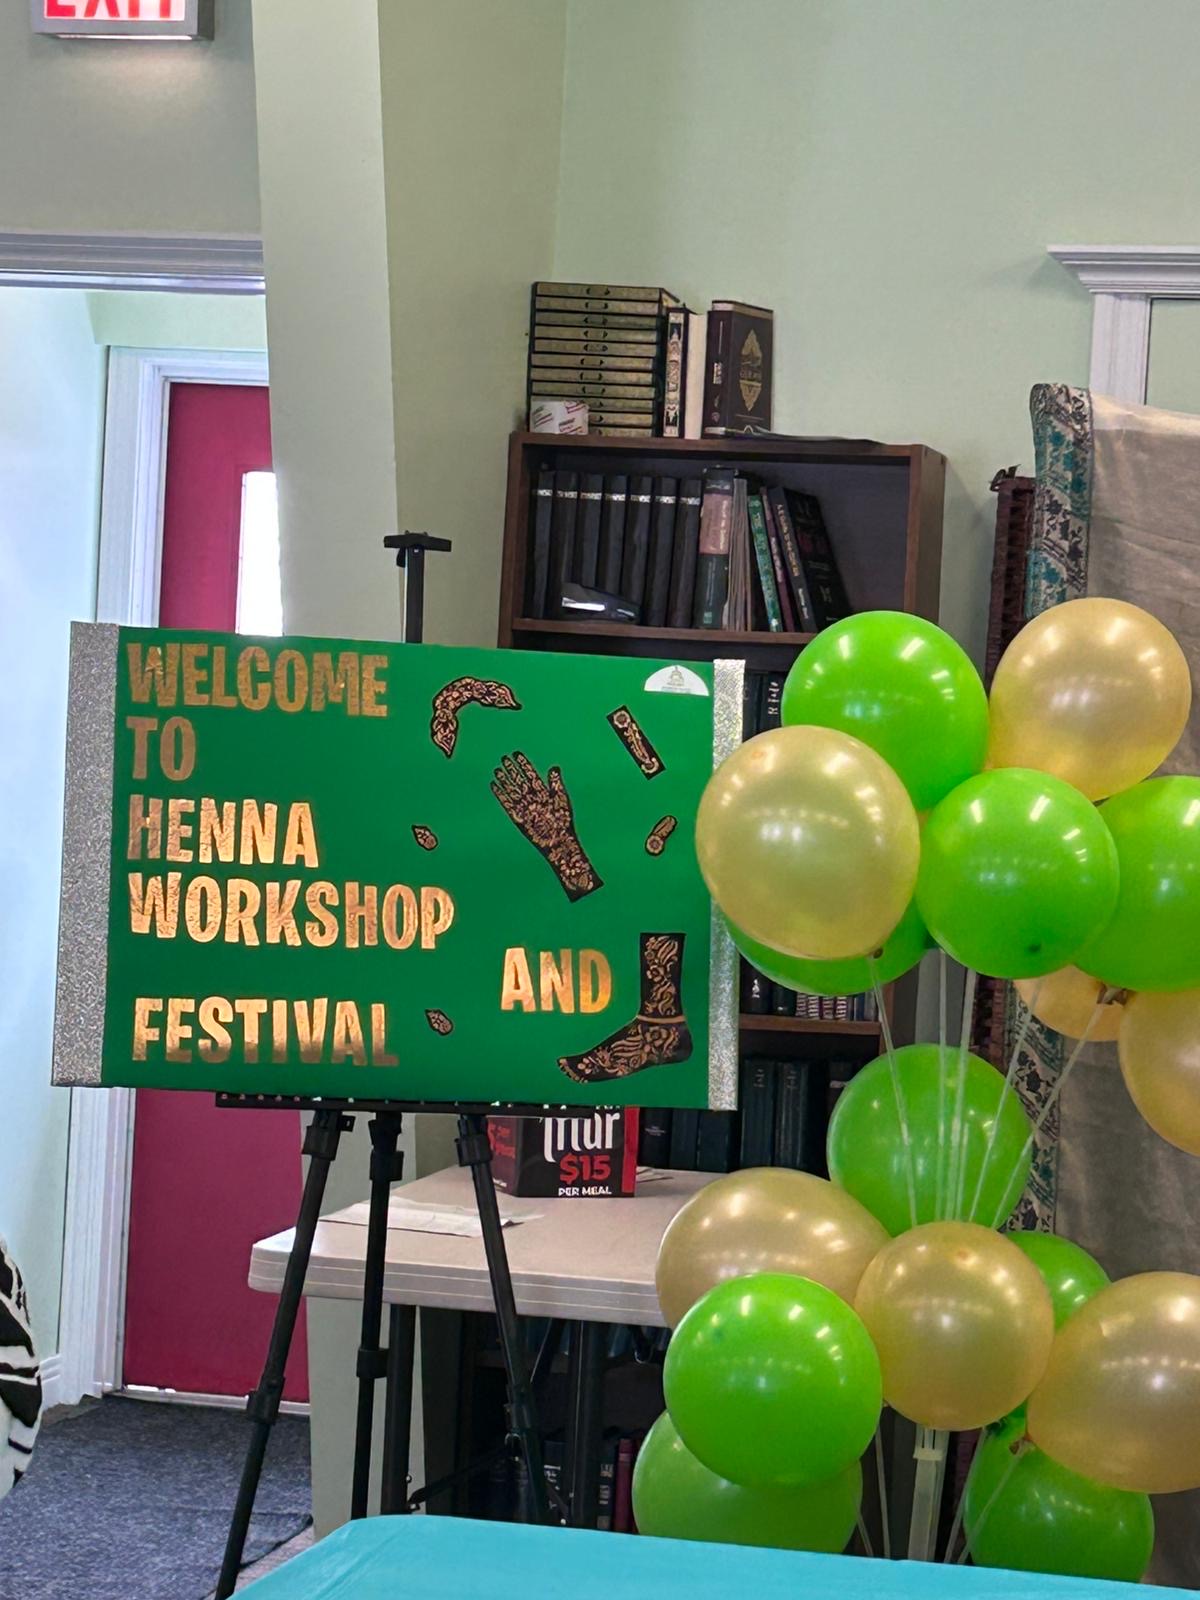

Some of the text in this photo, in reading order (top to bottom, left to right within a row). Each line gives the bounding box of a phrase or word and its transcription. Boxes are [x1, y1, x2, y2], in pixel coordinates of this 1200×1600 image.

[127, 643, 388, 717] WELCOME
[127, 716, 197, 781] TO
[127, 794, 319, 869] HENNA
[127, 872, 455, 950] WORKSHOP
[501, 947, 612, 1014] AND
[132, 996, 398, 1067] FESTIVAL
[558, 1185, 612, 1196] PER MEAL
[560, 1152, 611, 1185] $15
